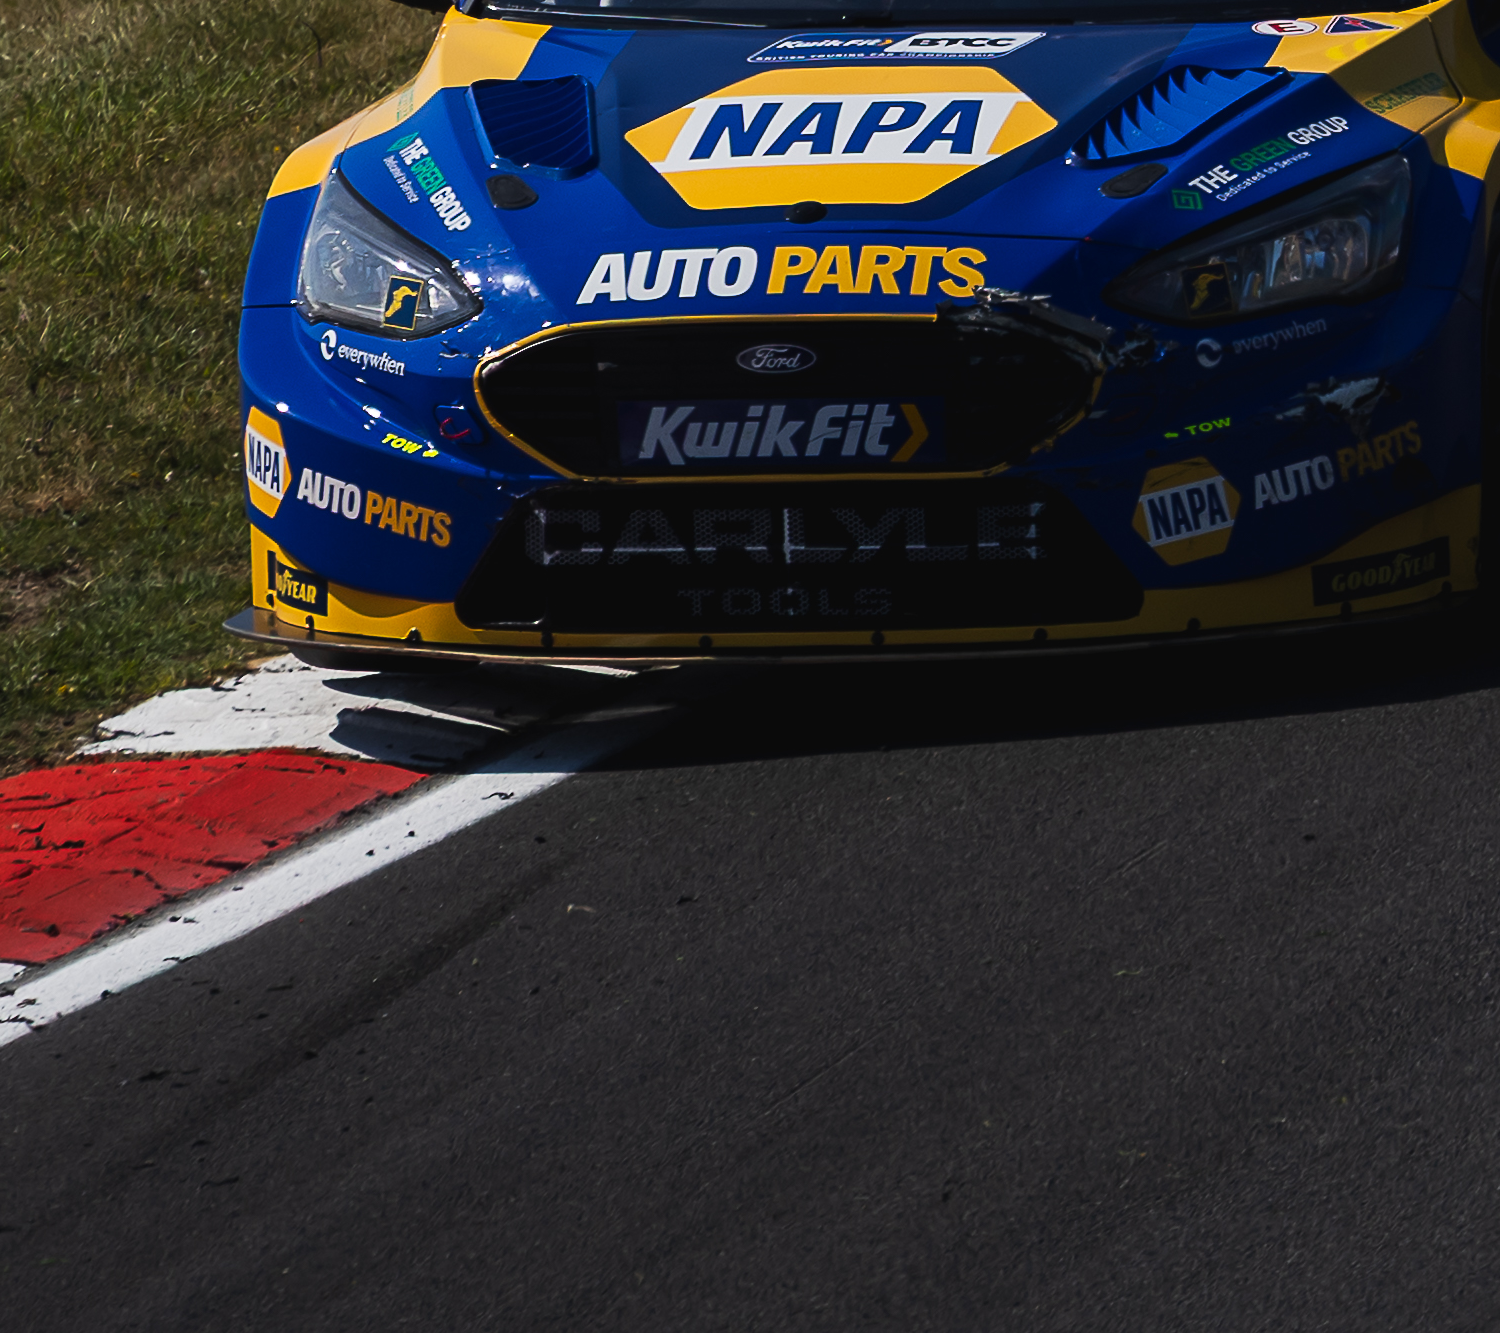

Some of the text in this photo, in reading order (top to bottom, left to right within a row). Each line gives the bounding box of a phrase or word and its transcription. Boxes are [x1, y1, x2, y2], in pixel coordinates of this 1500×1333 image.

[908, 37, 1017, 48] BTCC
[398, 137, 430, 166] THE
[689, 99, 984, 161] NAPA
[410, 156, 448, 196] GREEN
[1188, 115, 1349, 195] THE GREEN GROUP
[429, 186, 472, 232] GROUP
[576, 244, 988, 305] AUTO PARTS
[337, 341, 405, 377] everywhen
[750, 345, 803, 371] Ford
[381, 432, 424, 455] TOW
[1184, 417, 1232, 436] TOW
[248, 433, 281, 494] NAPA
[1254, 419, 1423, 510] AUTO PARTS
[296, 467, 452, 548] AUTO PARTS
[1147, 481, 1229, 541] NAPA
[523, 501, 1049, 567] CARLYLE
[1330, 551, 1437, 594] GOODYEAR
[676, 587, 894, 617] TOOLS
